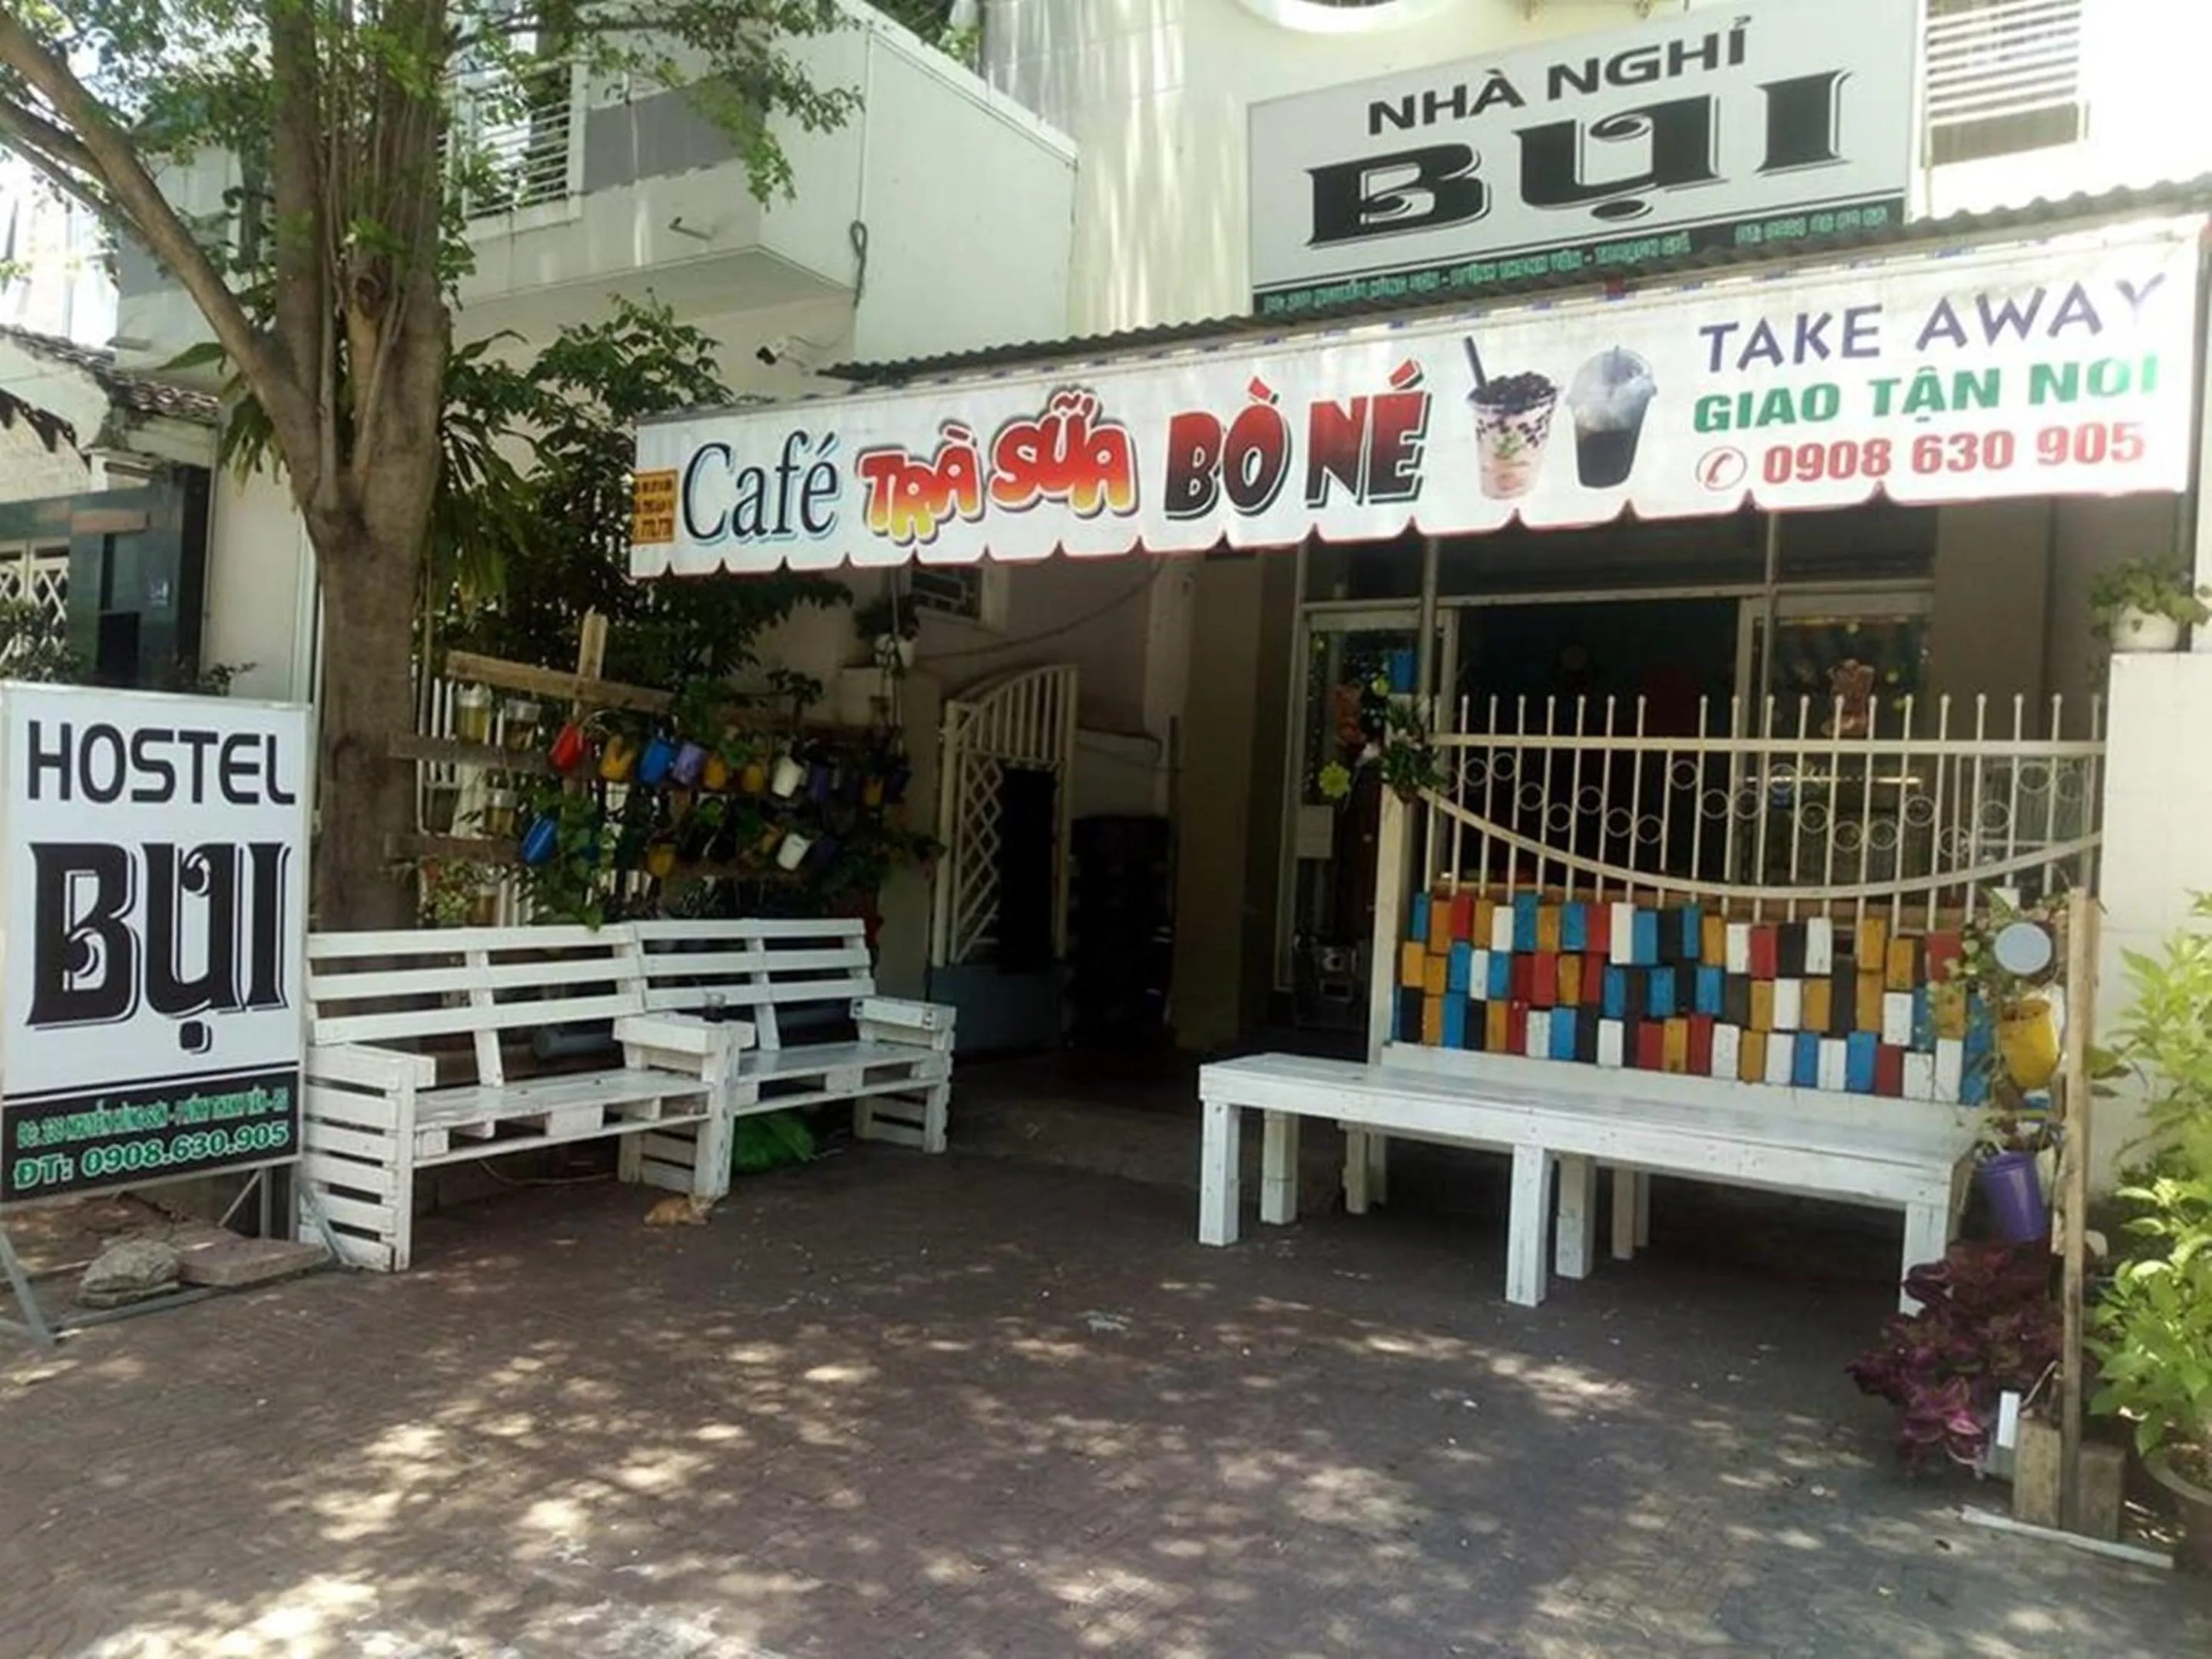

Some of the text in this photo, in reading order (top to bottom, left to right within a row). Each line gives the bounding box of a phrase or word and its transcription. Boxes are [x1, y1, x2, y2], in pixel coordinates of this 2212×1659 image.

[1368, 15, 1752, 135] NHÀ NGHỈ
[1303, 68, 1853, 248] BỤI
[1699, 272, 2167, 373] TAKE AWAY
[682, 430, 837, 540] Café
[1163, 374, 1292, 519] BÒ
[1303, 358, 1431, 510] NÉ
[1694, 383, 1840, 432] GIAO
[1868, 366, 2001, 422] TẬN
[1763, 421, 2146, 484] 0908 630 905
[26, 720, 296, 806] HOSTEL
[25, 842, 292, 1054] BỤI
[81, 1121, 290, 1177] 0908.630.905
